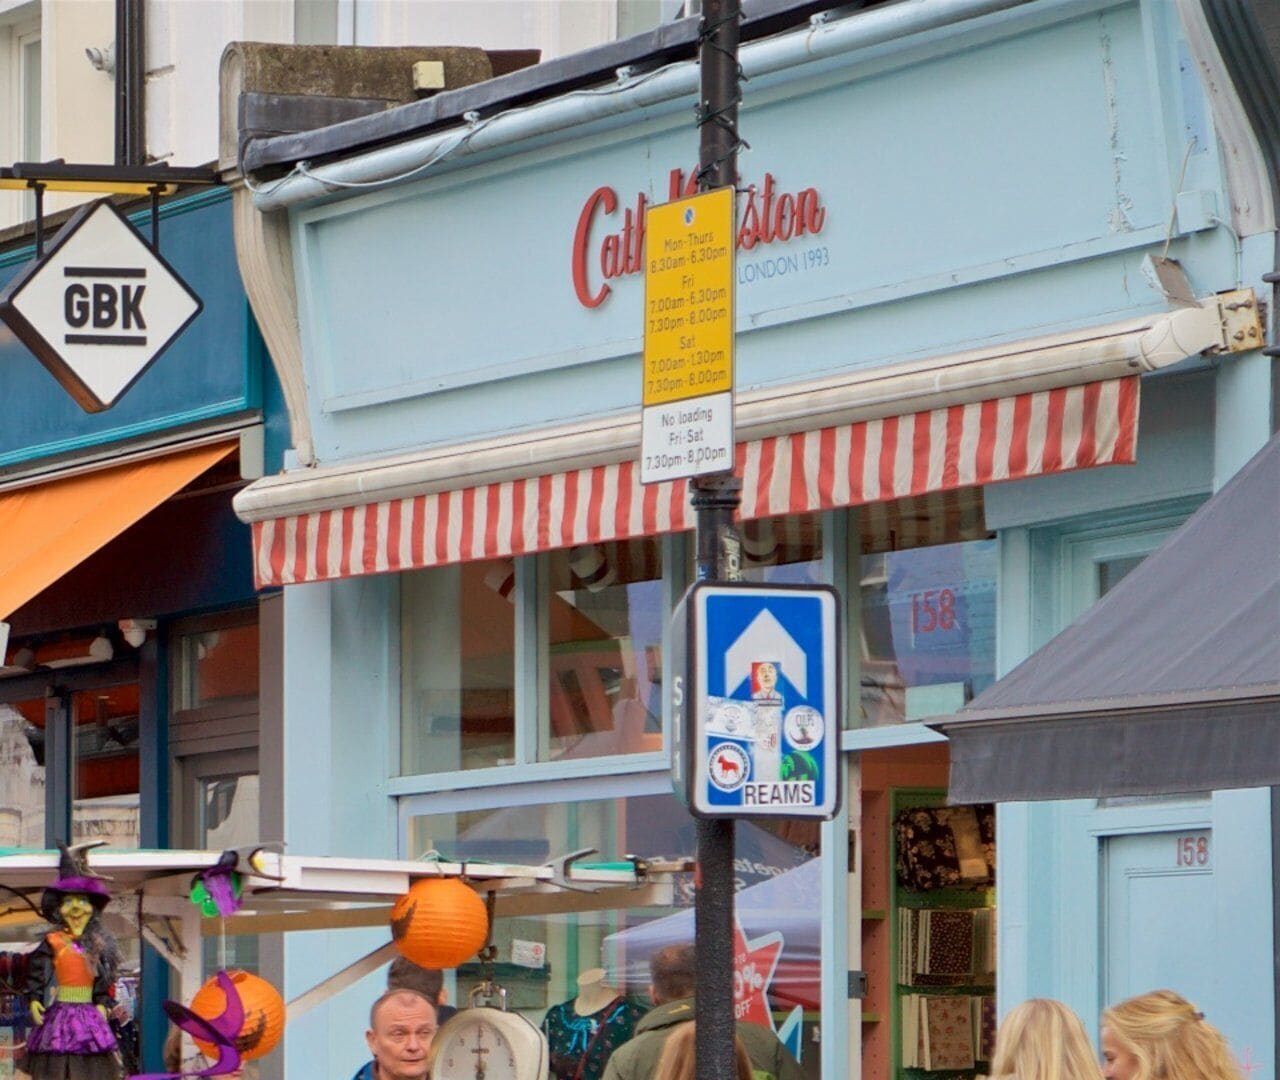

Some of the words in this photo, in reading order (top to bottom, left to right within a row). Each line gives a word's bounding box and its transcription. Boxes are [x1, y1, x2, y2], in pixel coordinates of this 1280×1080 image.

[682, 274, 695, 288] Fri
[739, 254, 798, 285] LONDON
[802, 247, 830, 272] 1993
[64, 282, 146, 330] GBK
[680, 335, 696, 350] Sat
[662, 413, 675, 427] No
[679, 407, 713, 425] loading
[911, 588, 956, 636] 158
[743, 783, 814, 805] REAMS
[1176, 836, 1209, 867] 158
[734, 962, 763, 999] 0%
